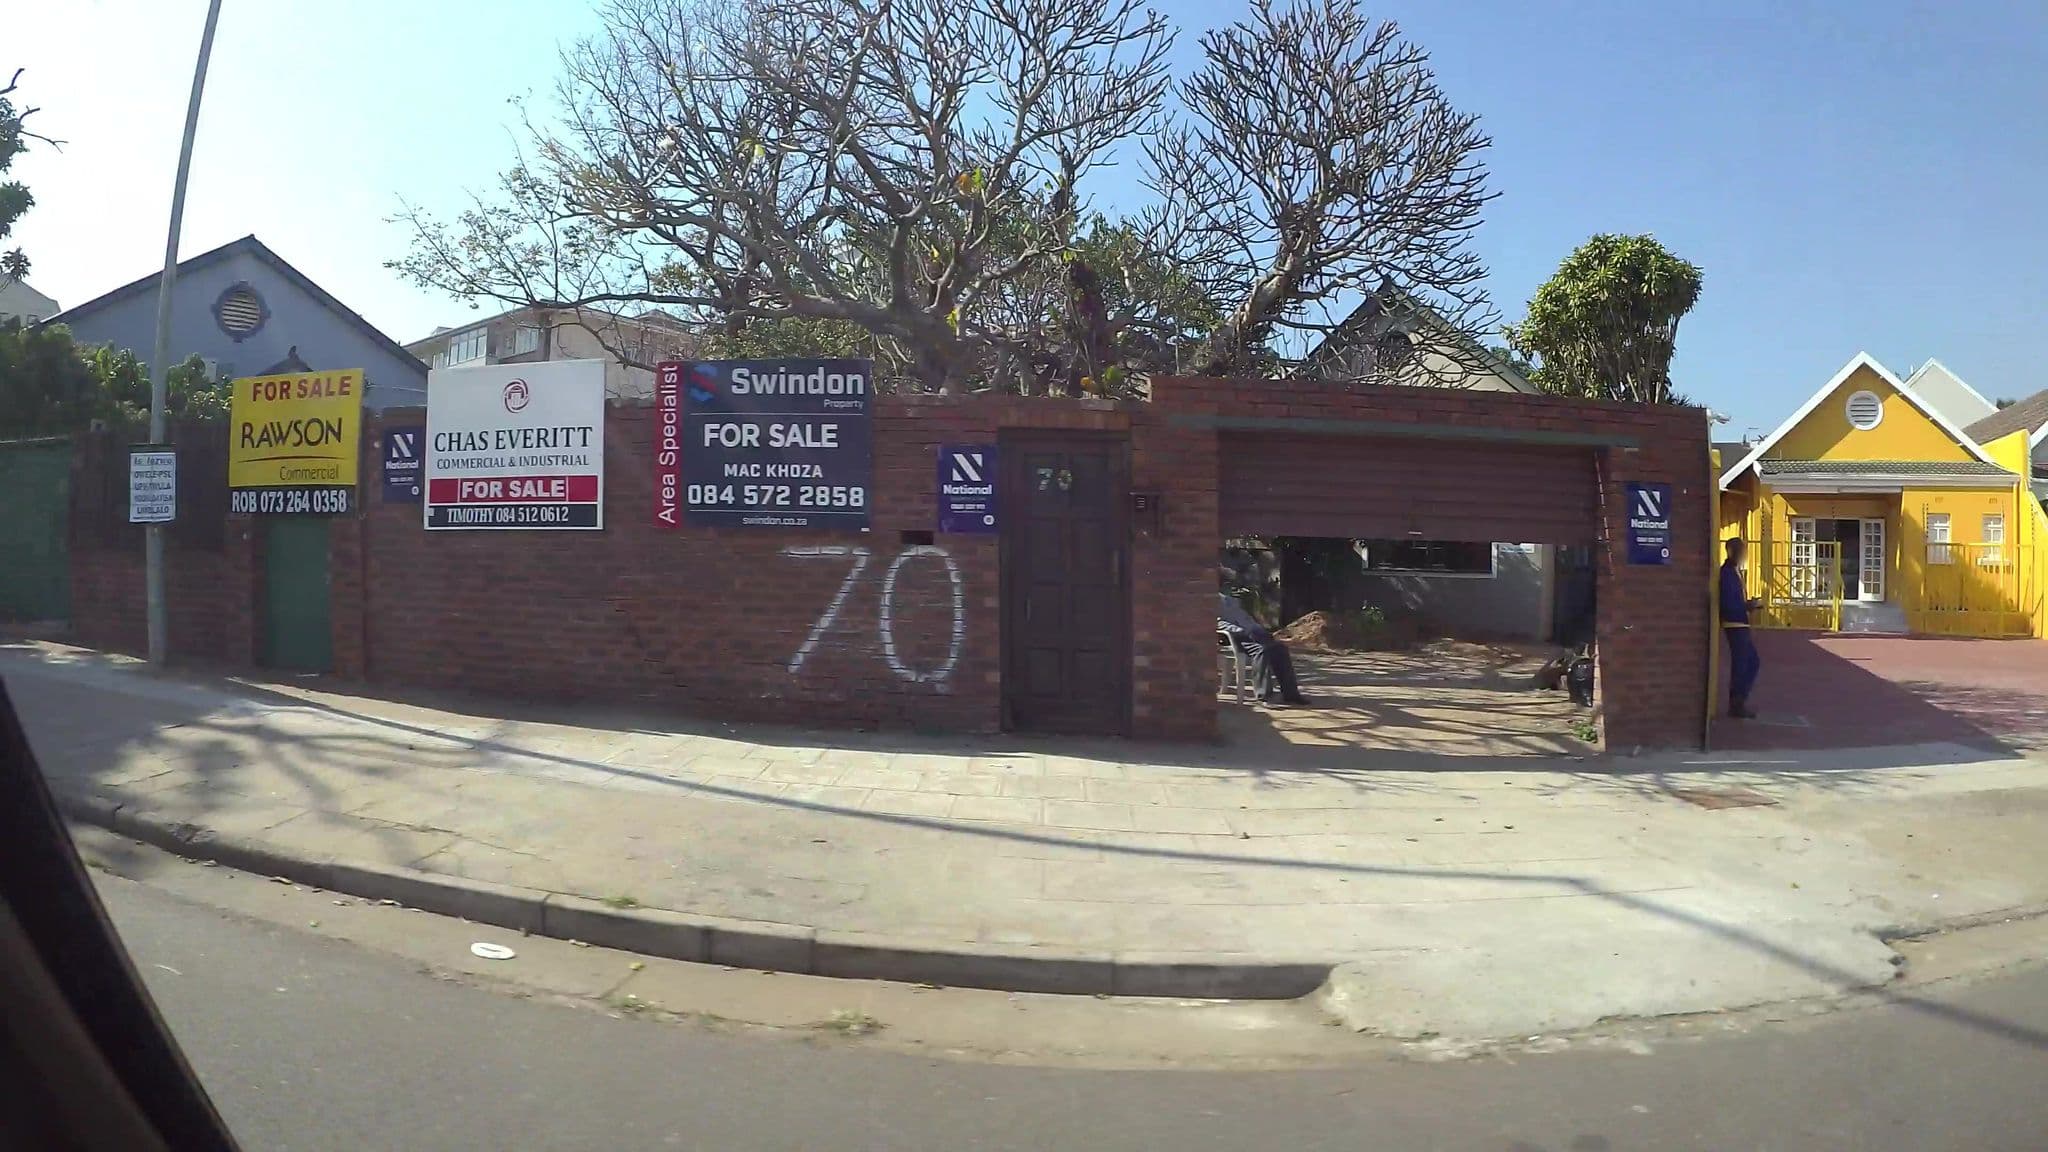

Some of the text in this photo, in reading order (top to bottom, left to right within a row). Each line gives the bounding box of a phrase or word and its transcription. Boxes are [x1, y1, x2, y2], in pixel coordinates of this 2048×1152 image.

[252, 376, 352, 402] FOR SALE
[731, 367, 864, 395] Swindon
[824, 399, 864, 409] Property
[241, 417, 343, 449] RAWSON
[434, 426, 593, 452] CHAS EVERITT
[703, 423, 839, 448] FOR SALE
[658, 365, 680, 524] Area Specialist
[385, 459, 419, 470] National
[437, 454, 589, 470] COMMERCIAL & INDUSTRIAL
[724, 463, 823, 478] MAC KHOZA
[279, 464, 339, 481] Commercial
[462, 479, 565, 498] FOR SALE
[687, 484, 865, 507] 084 572 2858
[943, 484, 992, 496] National
[232, 489, 347, 513] ROB 073 264 0358
[447, 506, 569, 523] TIMOTHY 084 512 0612
[742, 516, 808, 526] swindon.co.za
[1630, 518, 1669, 530] National
[776, 544, 968, 684] 70
